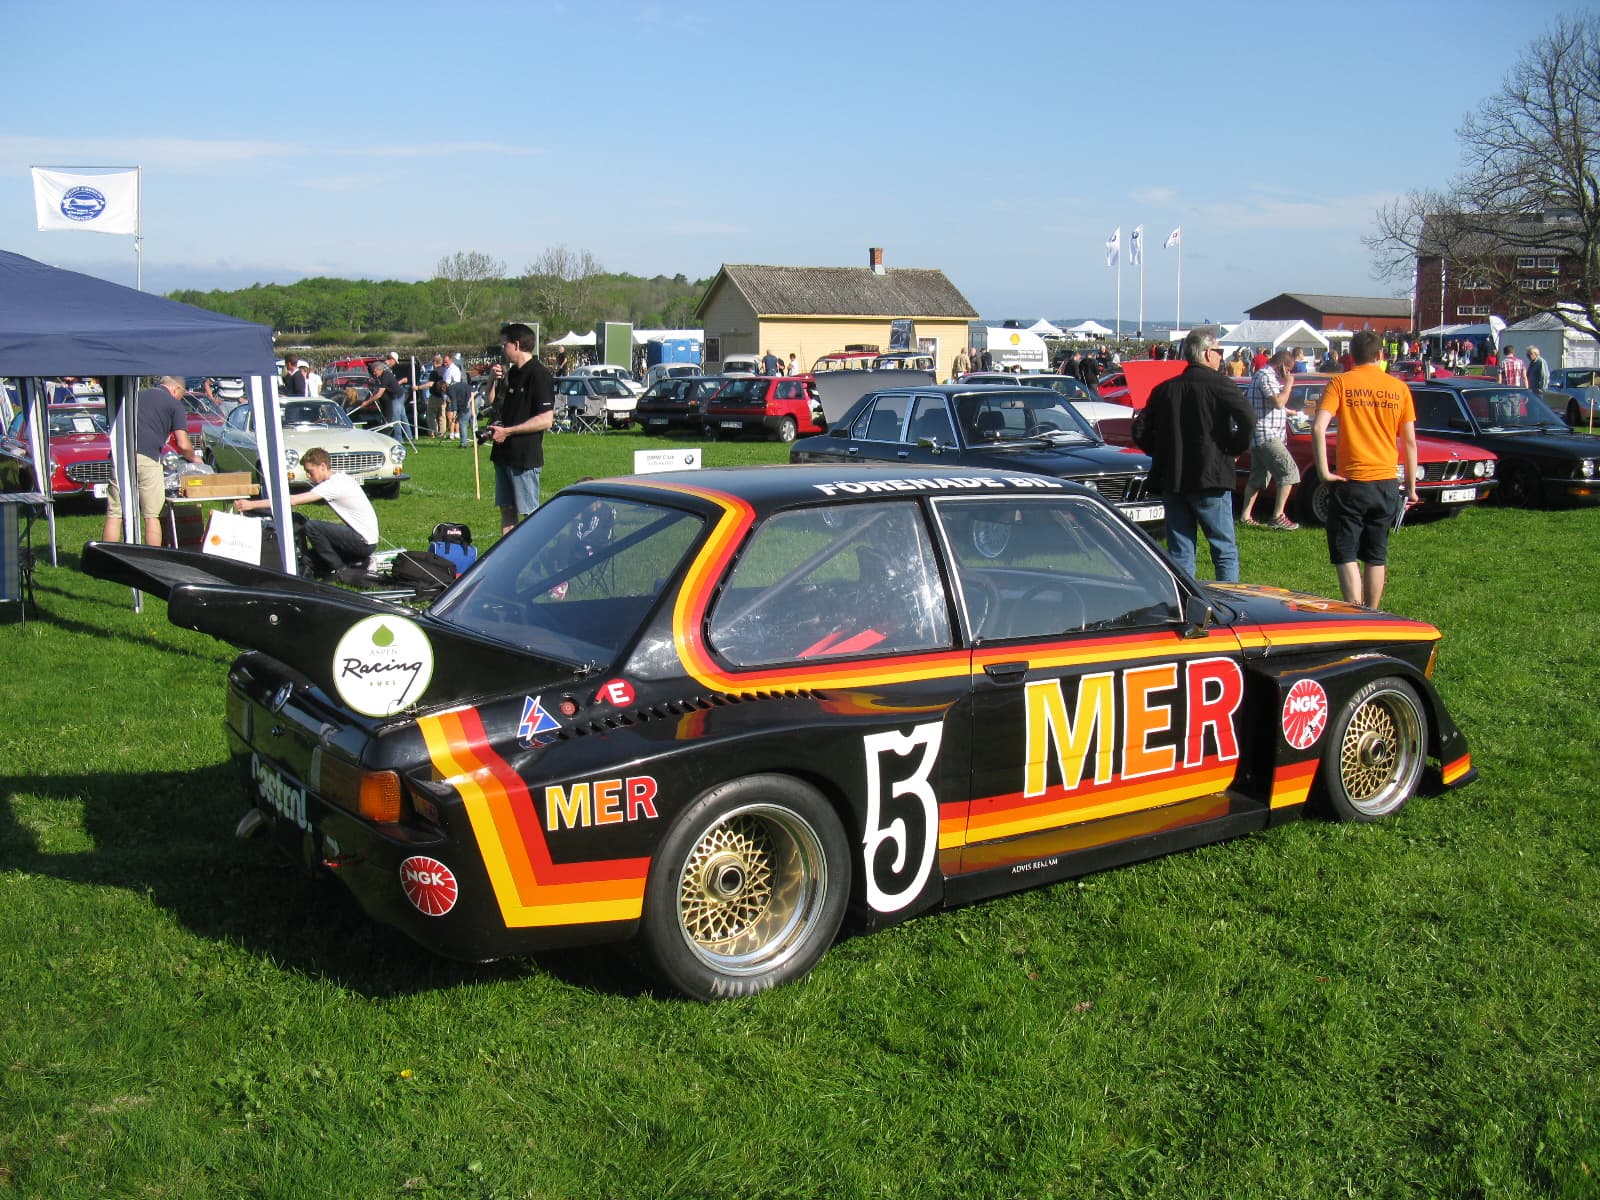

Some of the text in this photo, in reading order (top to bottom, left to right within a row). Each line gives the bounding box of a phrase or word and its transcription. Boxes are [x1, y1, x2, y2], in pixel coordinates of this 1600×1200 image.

[1345, 389, 1400, 400] BMW Club
[1346, 398, 1399, 409] Schweden
[813, 477, 1063, 496] FÖRENADE BIL
[341, 658, 423, 706] Racing
[607, 682, 630, 704] E
[1290, 694, 1321, 714] NGK
[1024, 657, 1244, 798] MER
[545, 775, 659, 832] MER
[862, 721, 944, 913] 5
[406, 869, 445, 886] NGK
